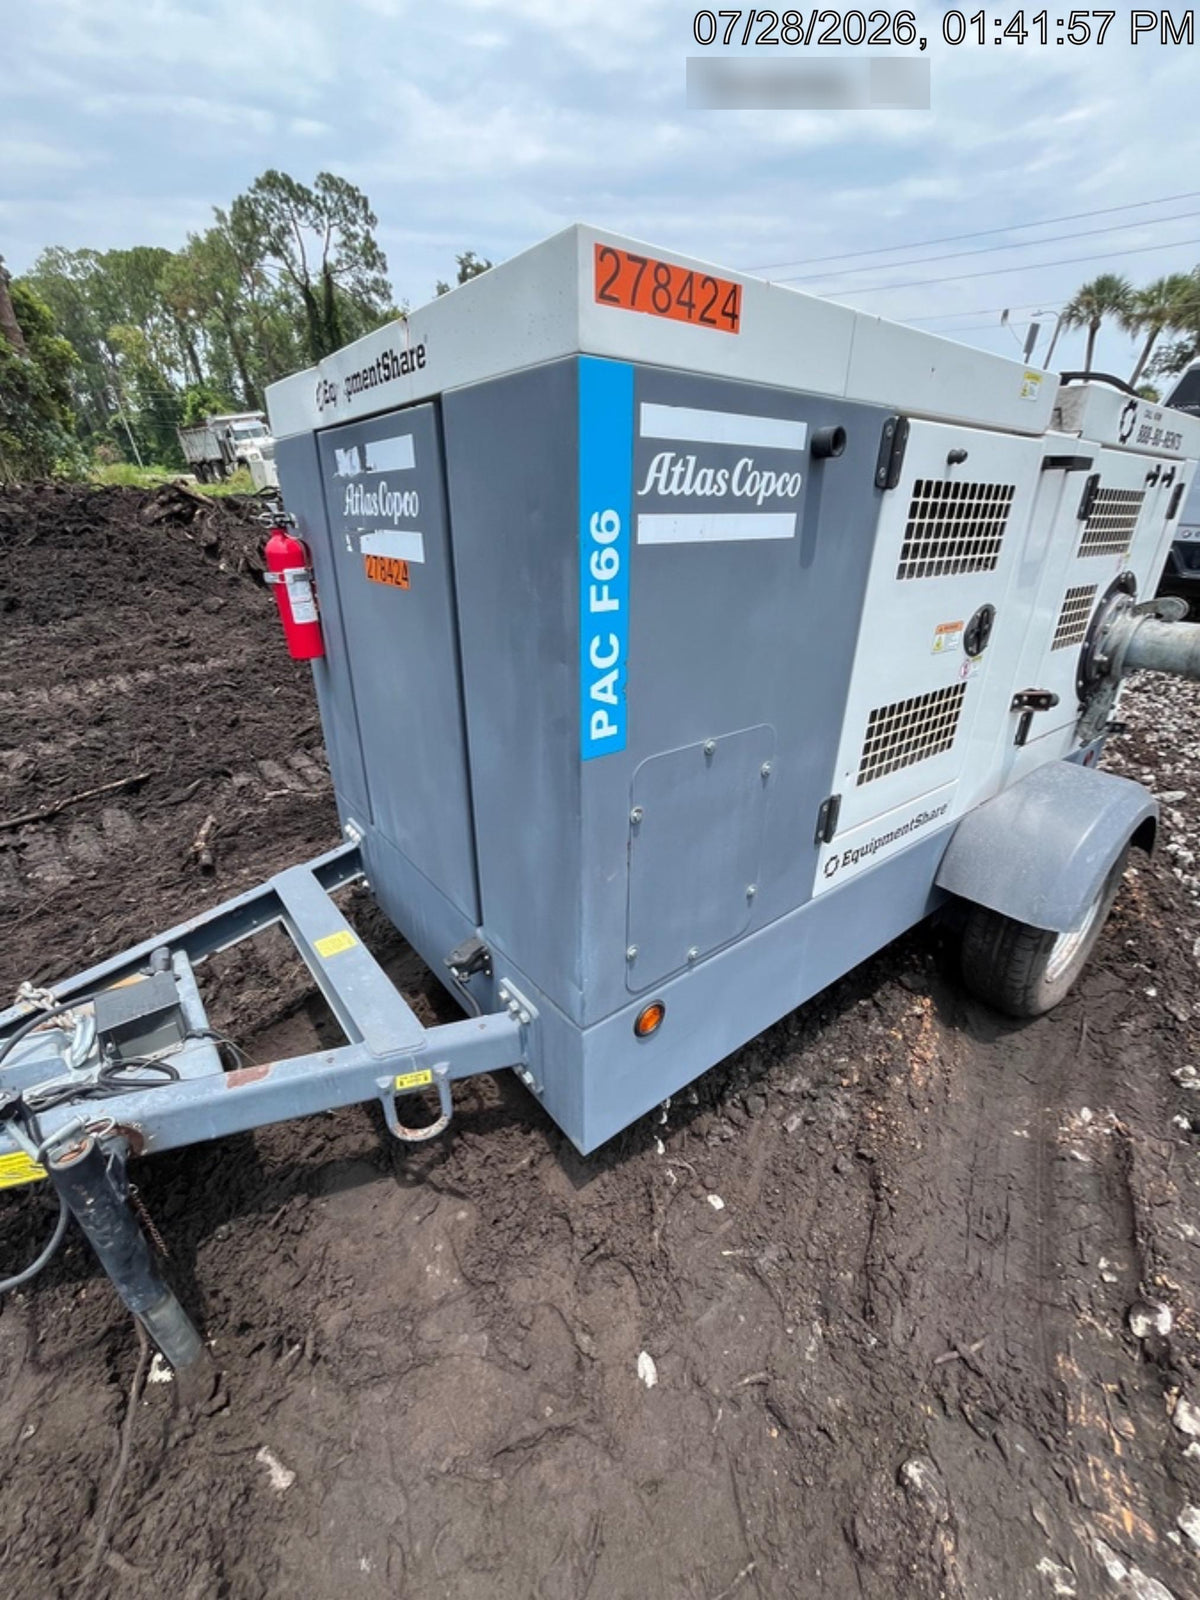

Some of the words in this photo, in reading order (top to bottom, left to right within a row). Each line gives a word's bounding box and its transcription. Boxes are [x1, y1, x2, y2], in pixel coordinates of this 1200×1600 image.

[598, 246, 739, 329] 278424
[343, 483, 379, 517] Atlas
[378, 481, 419, 526] Copco
[636, 452, 729, 497] Atlas
[731, 457, 802, 506] Copco
[590, 509, 621, 613] F66
[590, 633, 619, 741] PAC
[841, 802, 949, 869] EquipmentShare
